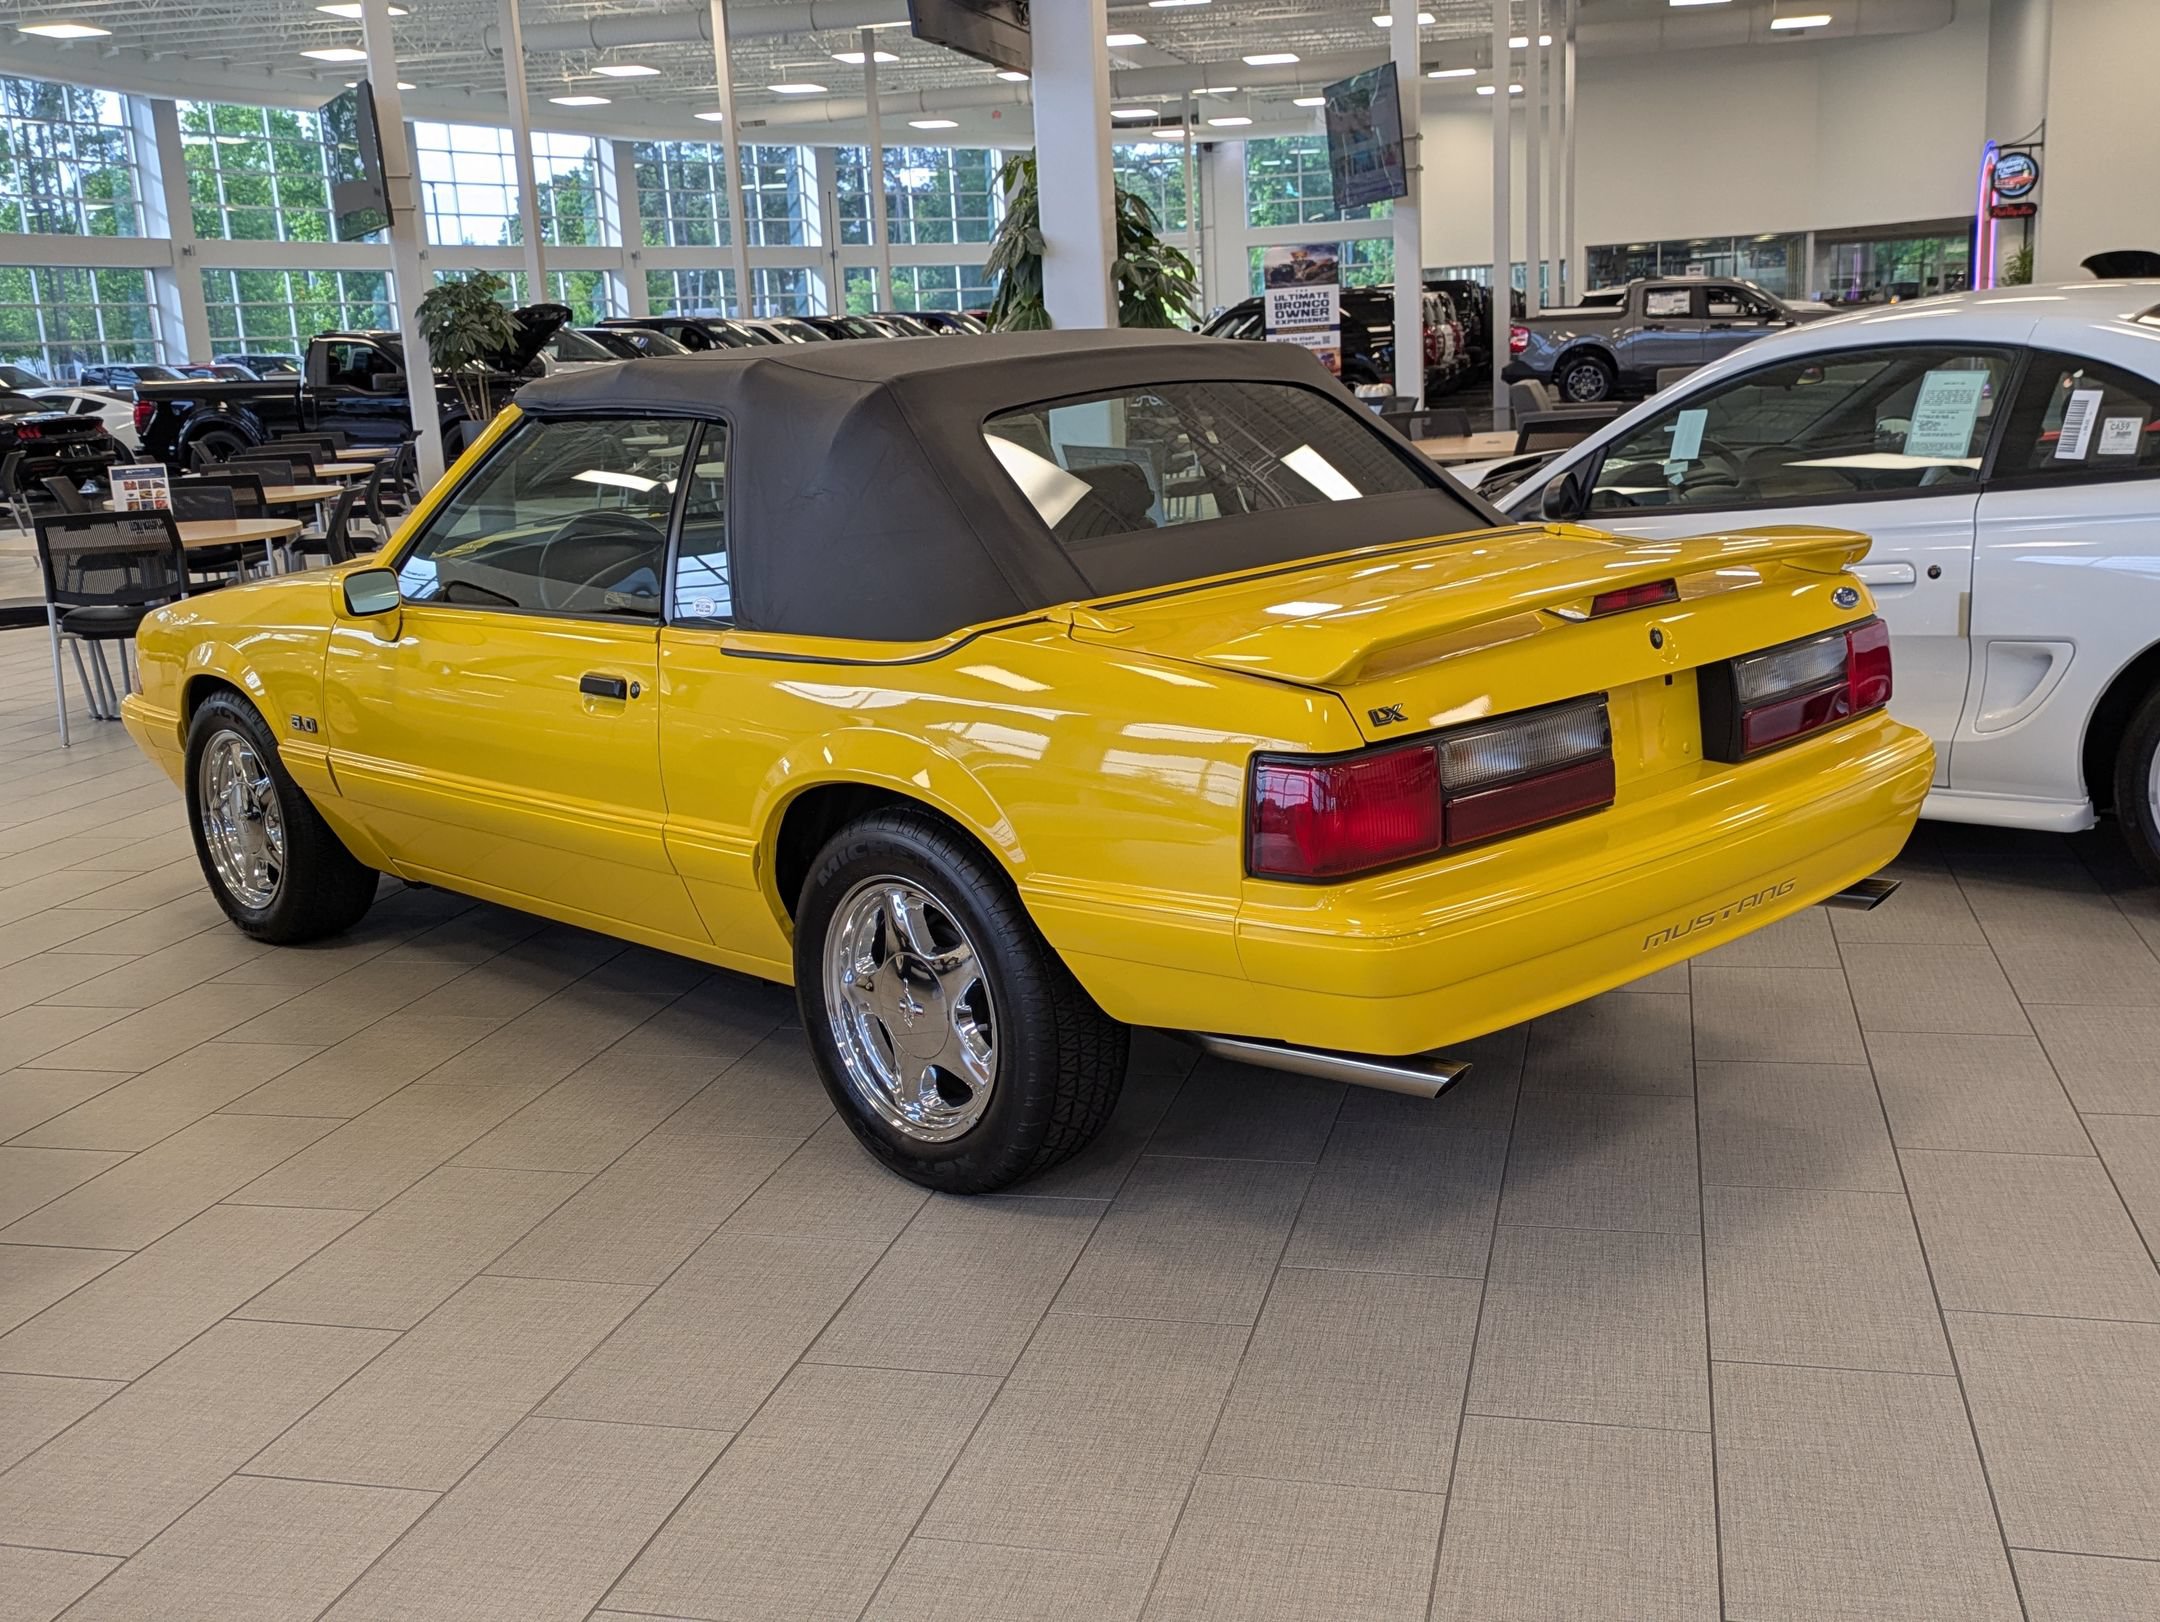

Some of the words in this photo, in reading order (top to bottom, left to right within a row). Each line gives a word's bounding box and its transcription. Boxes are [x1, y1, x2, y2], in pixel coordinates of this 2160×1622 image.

[1274, 291, 1329, 302] ULTIMATE
[1274, 299, 1330, 311] BRONCO
[1275, 307, 1329, 319] OWNER
[1275, 317, 1330, 325] EXPERIENCE
[1368, 703, 1409, 727] LX
[1641, 876, 1798, 952] MUSTANG
